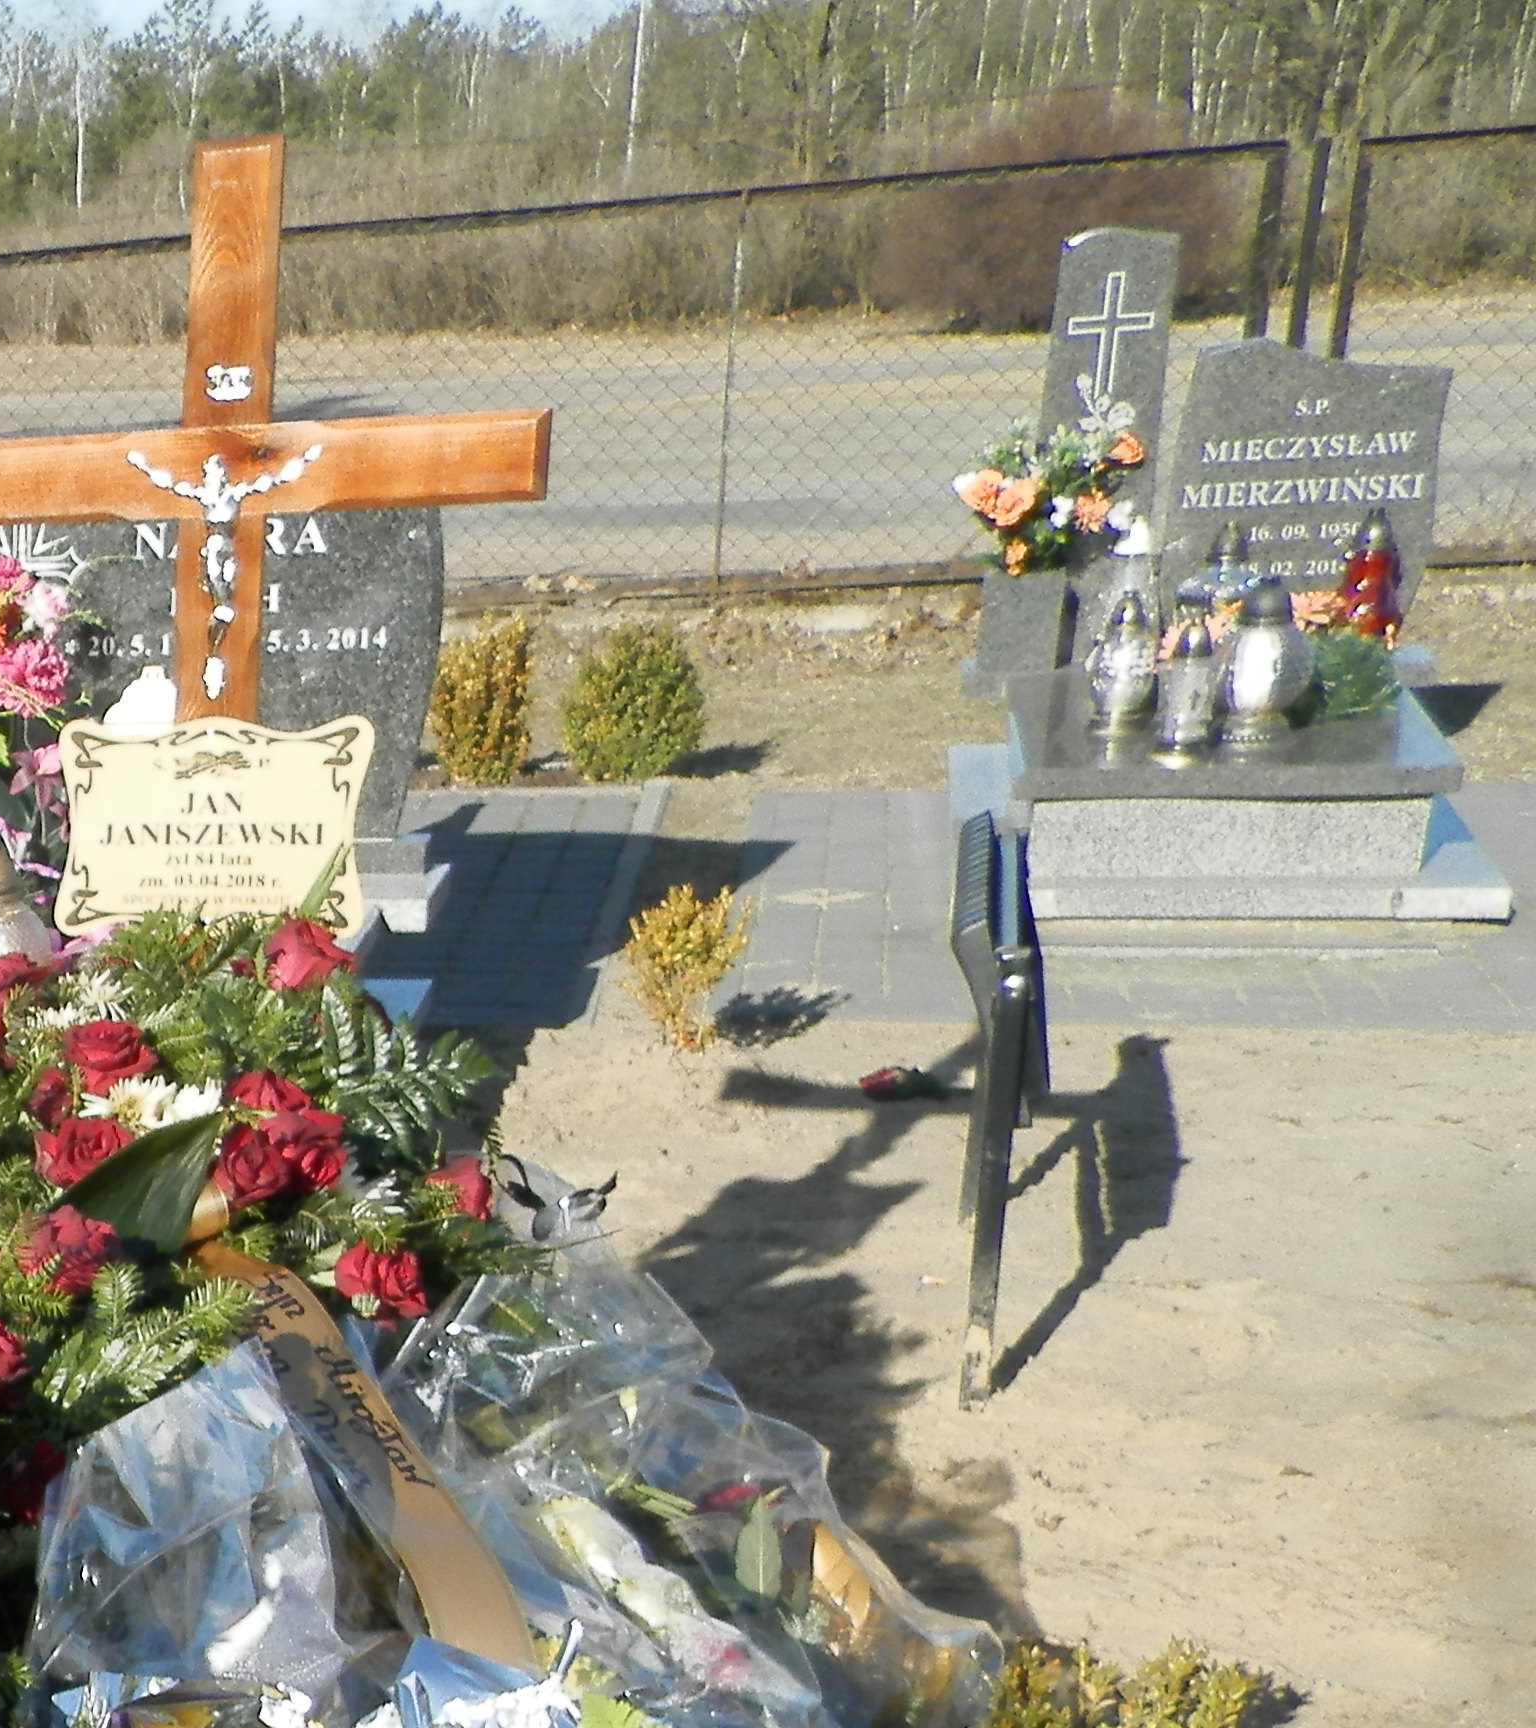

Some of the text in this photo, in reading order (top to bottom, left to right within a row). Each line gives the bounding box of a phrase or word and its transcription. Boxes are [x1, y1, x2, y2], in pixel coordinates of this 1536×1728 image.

[1201, 430, 1417, 463] MIECZYSŁAW
[1181, 468, 1426, 508] MIERZWIŃSKI
[180, 792, 244, 815] JAN
[100, 823, 324, 846] JANISZEWSKI
[174, 875, 264, 889] 03.04.2018
